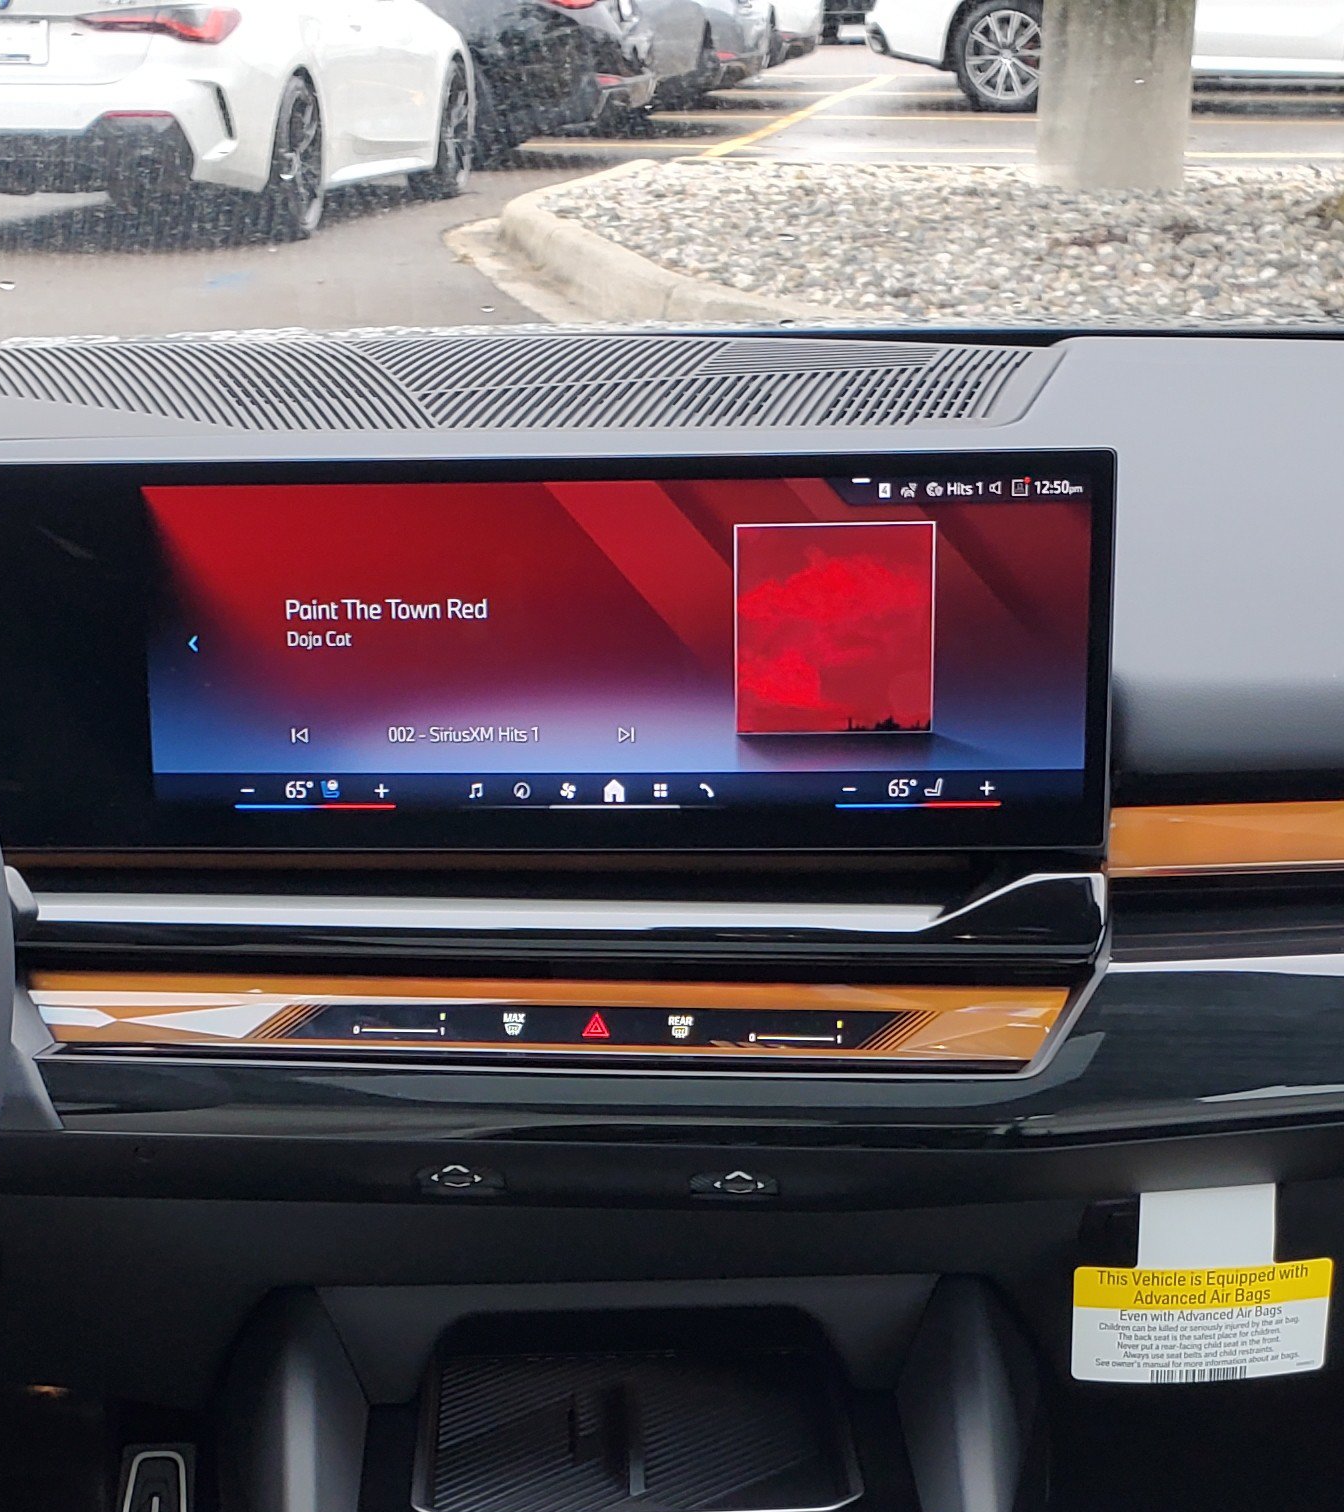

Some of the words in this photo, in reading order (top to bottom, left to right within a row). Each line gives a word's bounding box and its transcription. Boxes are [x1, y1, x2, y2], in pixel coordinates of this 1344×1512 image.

[946, 482, 973, 496] Hits
[976, 481, 983, 495] 1
[285, 599, 338, 620] Paint
[341, 598, 382, 620] The
[385, 598, 441, 619] Town
[447, 598, 488, 619] Red
[287, 631, 322, 650] Doja
[326, 631, 352, 647] Cat
[388, 726, 416, 742] 002
[429, 726, 494, 743] SiriusXM
[499, 726, 527, 742] Hits
[530, 726, 539, 742] 1
[285, 780, 314, 799] 65°
[888, 778, 918, 797] 65°
[502, 1012, 526, 1023] MAX
[668, 1015, 694, 1026] REAR
[1097, 1270, 1128, 1286] This
[1132, 1272, 1186, 1287] Vehicle
[1190, 1271, 1202, 1286] is
[1206, 1267, 1276, 1288] Equipped
[1279, 1263, 1308, 1280] with
[1133, 1289, 1207, 1305] Advanced
[1210, 1289, 1231, 1304] Air
[1235, 1287, 1271, 1304] Bags
[1120, 1309, 1148, 1322] Even
[1150, 1309, 1174, 1322] with
[1177, 1308, 1234, 1322] Advanced
[1236, 1306, 1252, 1318] Air
[1255, 1305, 1282, 1318] Bags
[1099, 1322, 1131, 1331] Children
[1132, 1324, 1146, 1332] can
[1147, 1323, 1157, 1332] be
[1159, 1324, 1178, 1332] killed
[1190, 1323, 1223, 1332] seriously
[1225, 1322, 1250, 1330] injured
[1251, 1320, 1259, 1329] by
[1275, 1317, 1283, 1325] air
[1118, 1332, 1133, 1340] The
[1134, 1333, 1151, 1341] back
[1154, 1333, 1169, 1341] seat
[1171, 1333, 1178, 1341] is
[1179, 1333, 1192, 1341] the
[1193, 1333, 1216, 1341] safest
[1217, 1331, 1238, 1341] place
[1239, 1330, 1249, 1338] for
[1117, 1341, 1139, 1350] Never
[1140, 1343, 1154, 1351] put
[1161, 1342, 1203, 1351] rear-facing
[1204, 1341, 1222, 1349] child
[1223, 1340, 1238, 1348] seat
[1095, 1358, 1110, 1367] See
[1111, 1360, 1140, 1368] owner's
[1205, 1358, 1247, 1367] information
[1249, 1355, 1269, 1364] about
[1123, 1351, 1149, 1360] Always
[1183, 1351, 1202, 1359] belts
[1204, 1350, 1218, 1358] and
[1219, 1348, 1237, 1357] child
